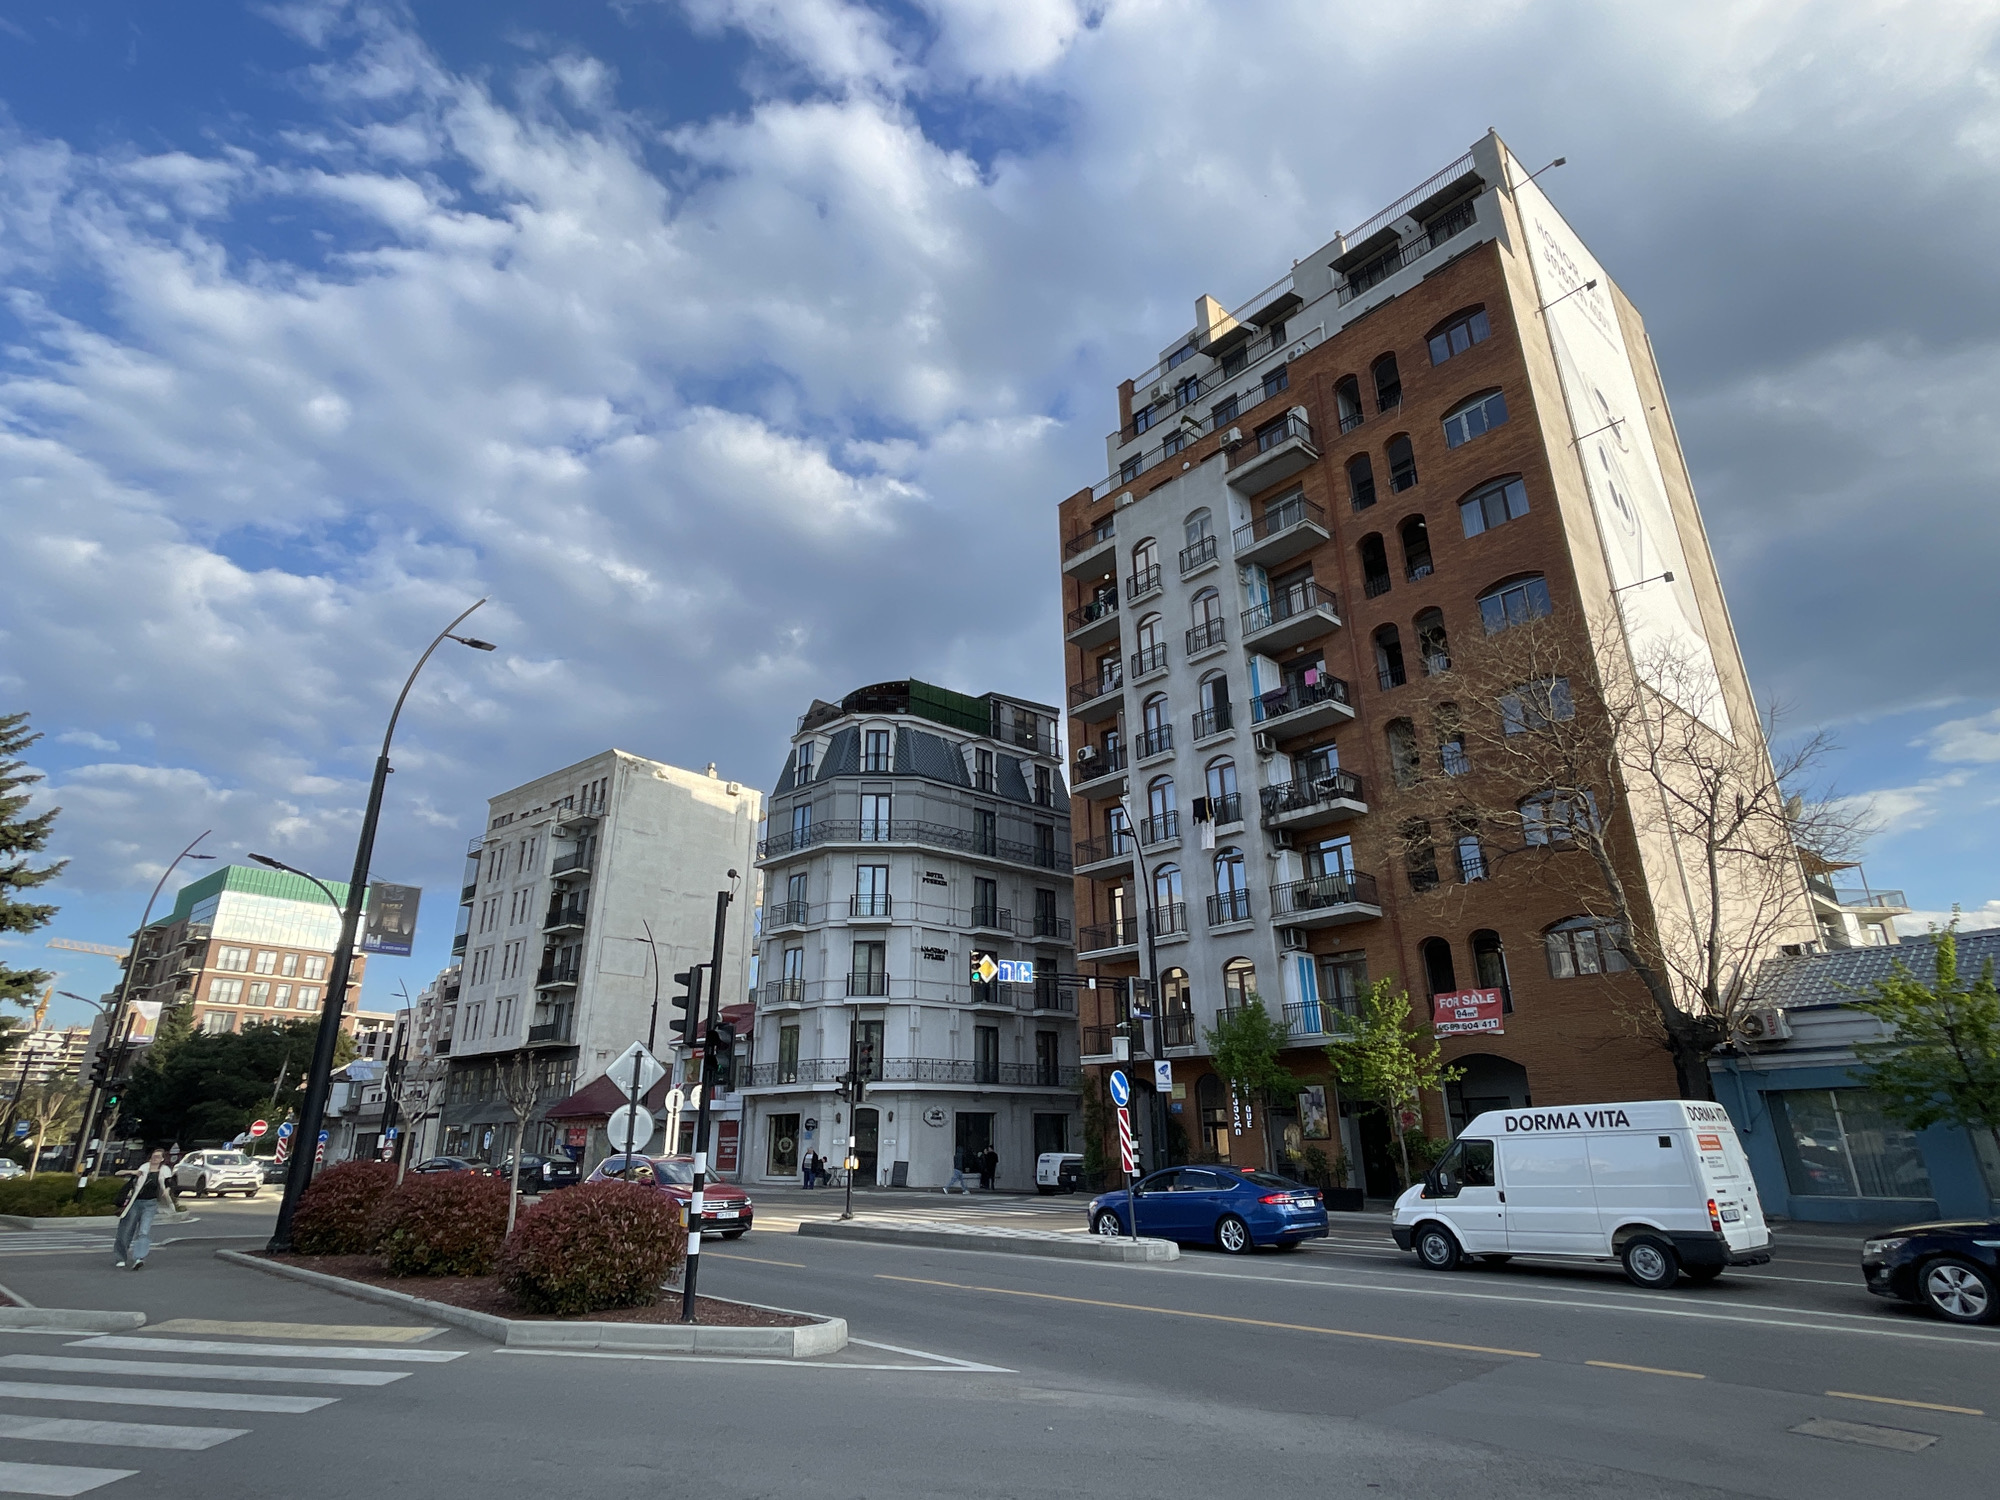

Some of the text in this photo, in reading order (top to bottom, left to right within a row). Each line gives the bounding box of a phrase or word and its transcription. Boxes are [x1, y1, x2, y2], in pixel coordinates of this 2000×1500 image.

[1535, 217, 1581, 282] HONOR
[1440, 993, 1496, 1009] FOR SALE
[1482, 1019, 1497, 1028] 411
[1505, 1110, 1630, 1132] DORMA VITA
[1686, 1106, 1716, 1121] DORMA
